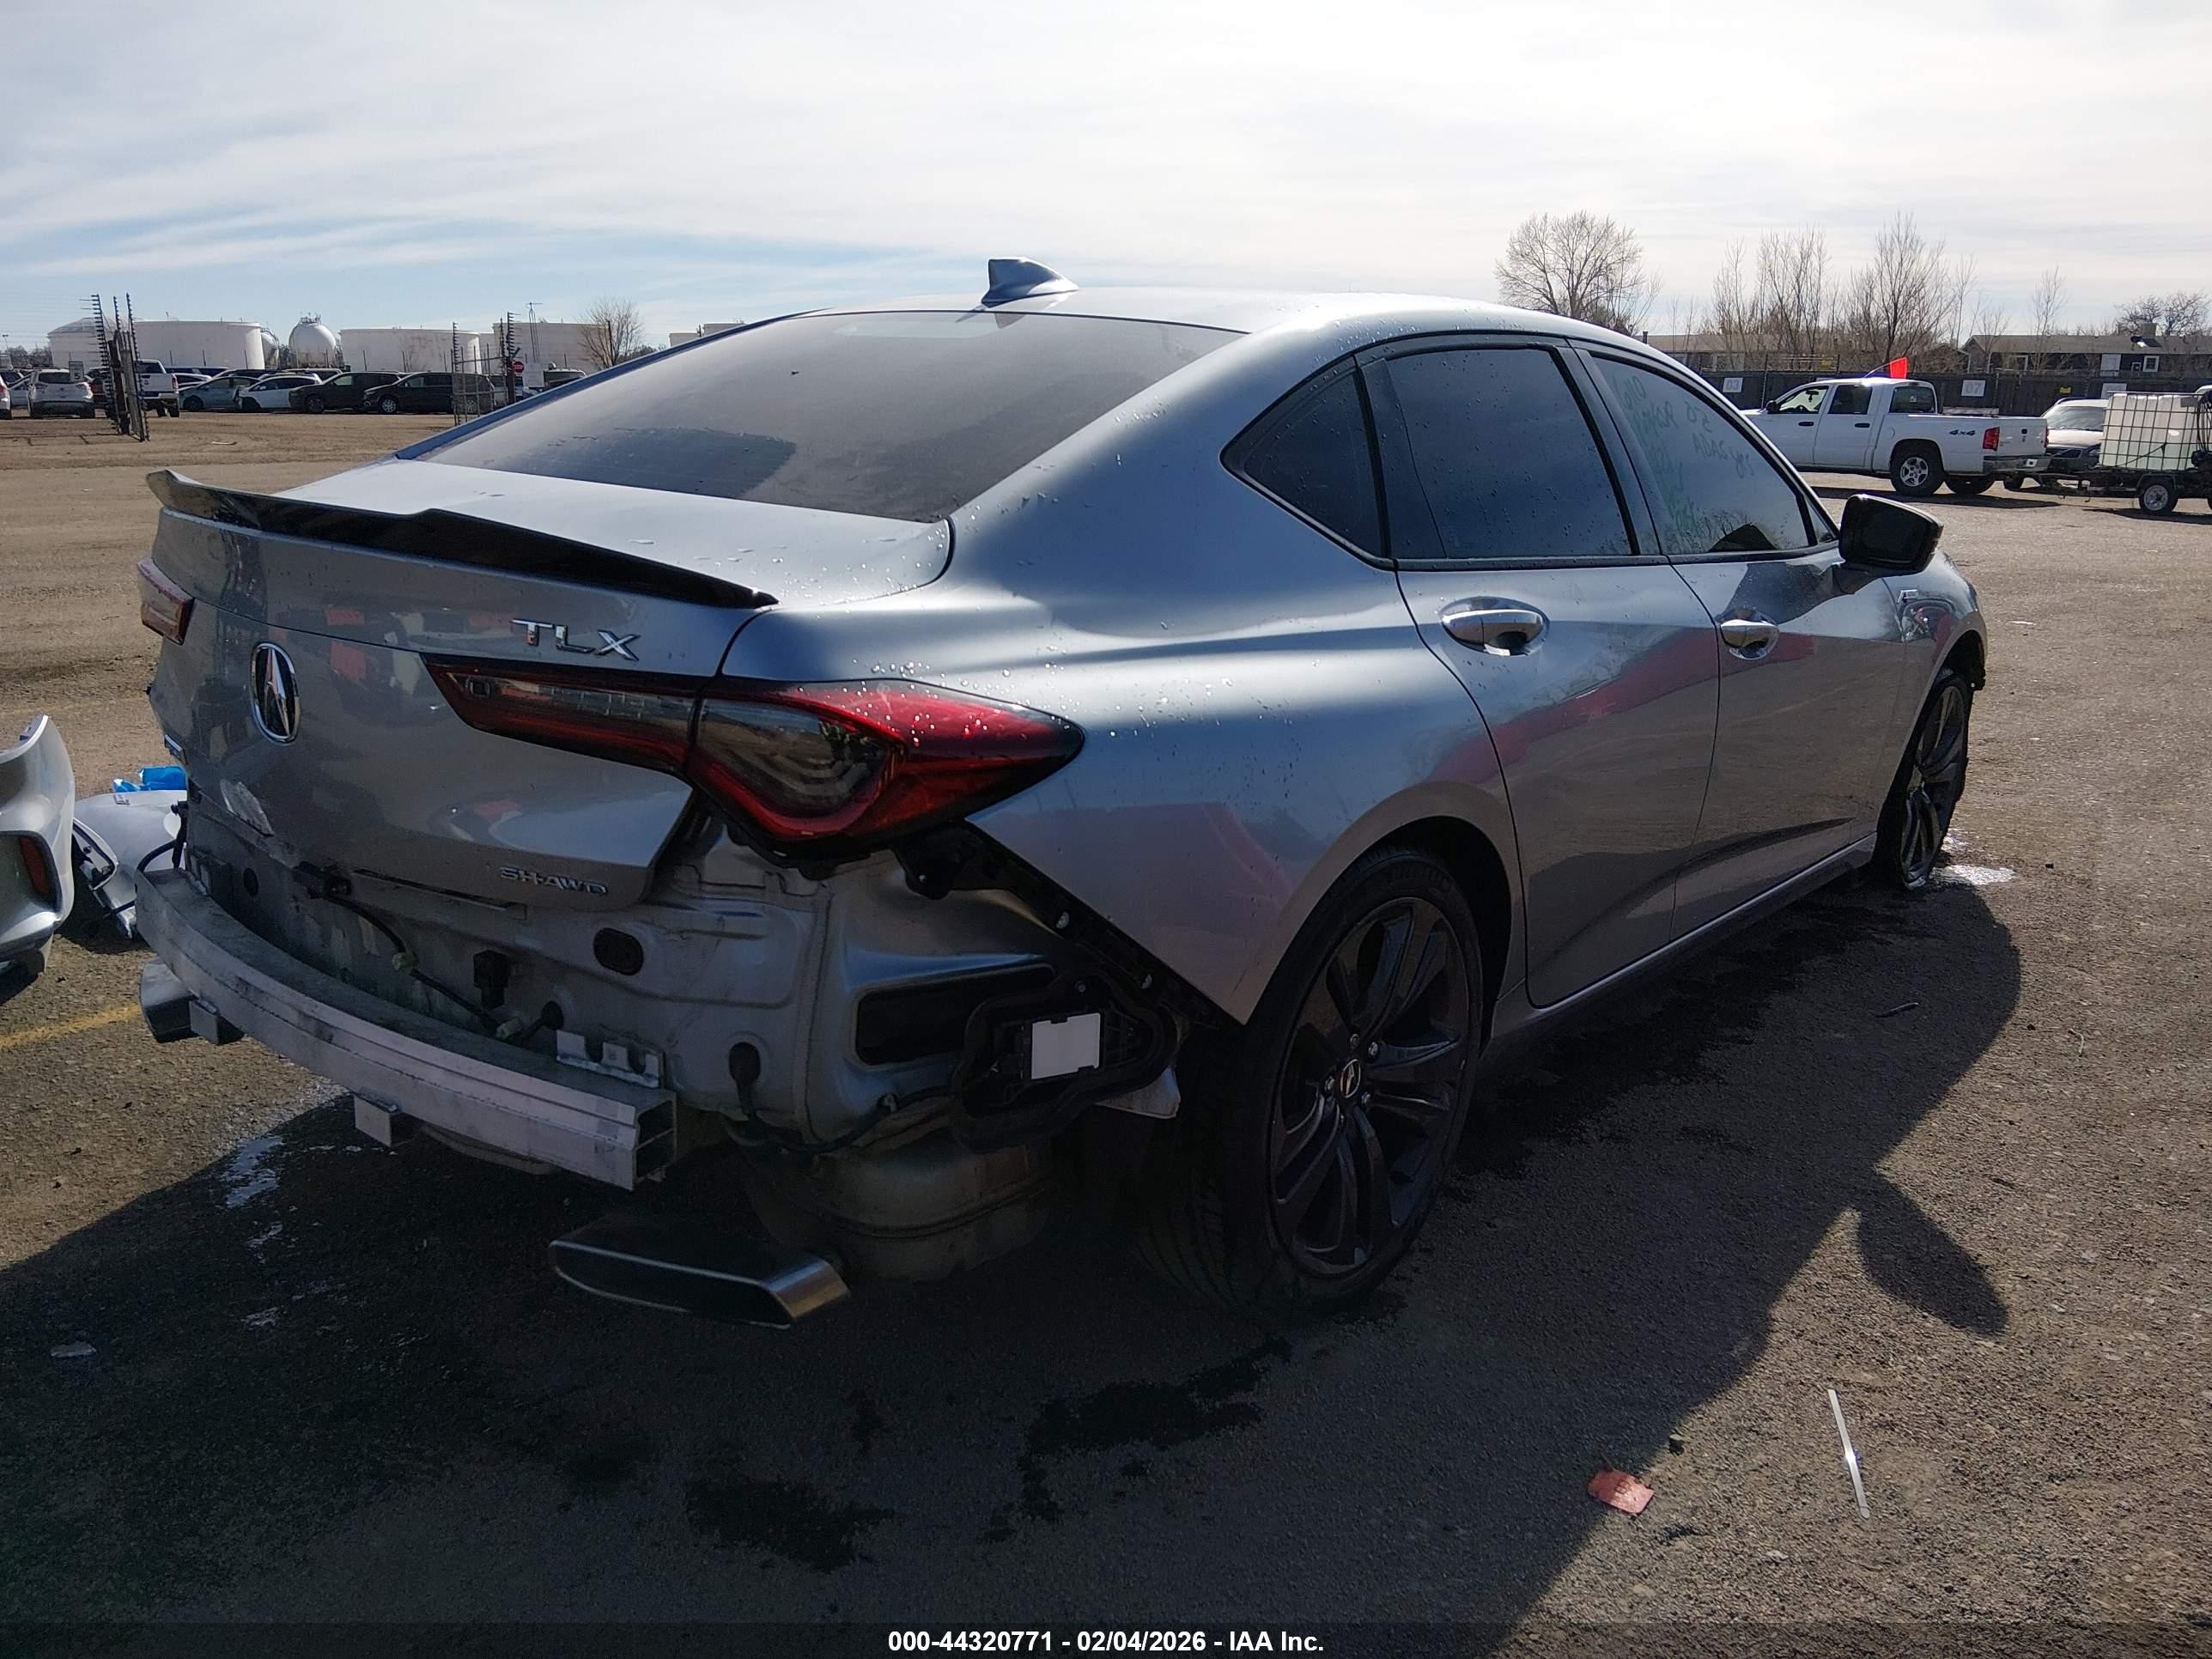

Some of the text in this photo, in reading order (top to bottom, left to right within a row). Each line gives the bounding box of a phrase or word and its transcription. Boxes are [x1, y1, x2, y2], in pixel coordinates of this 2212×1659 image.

[1726, 379, 1740, 391] 03
[1966, 383, 1979, 393] 07
[509, 618, 641, 661] TLX
[499, 866, 607, 894] SH-AWD
